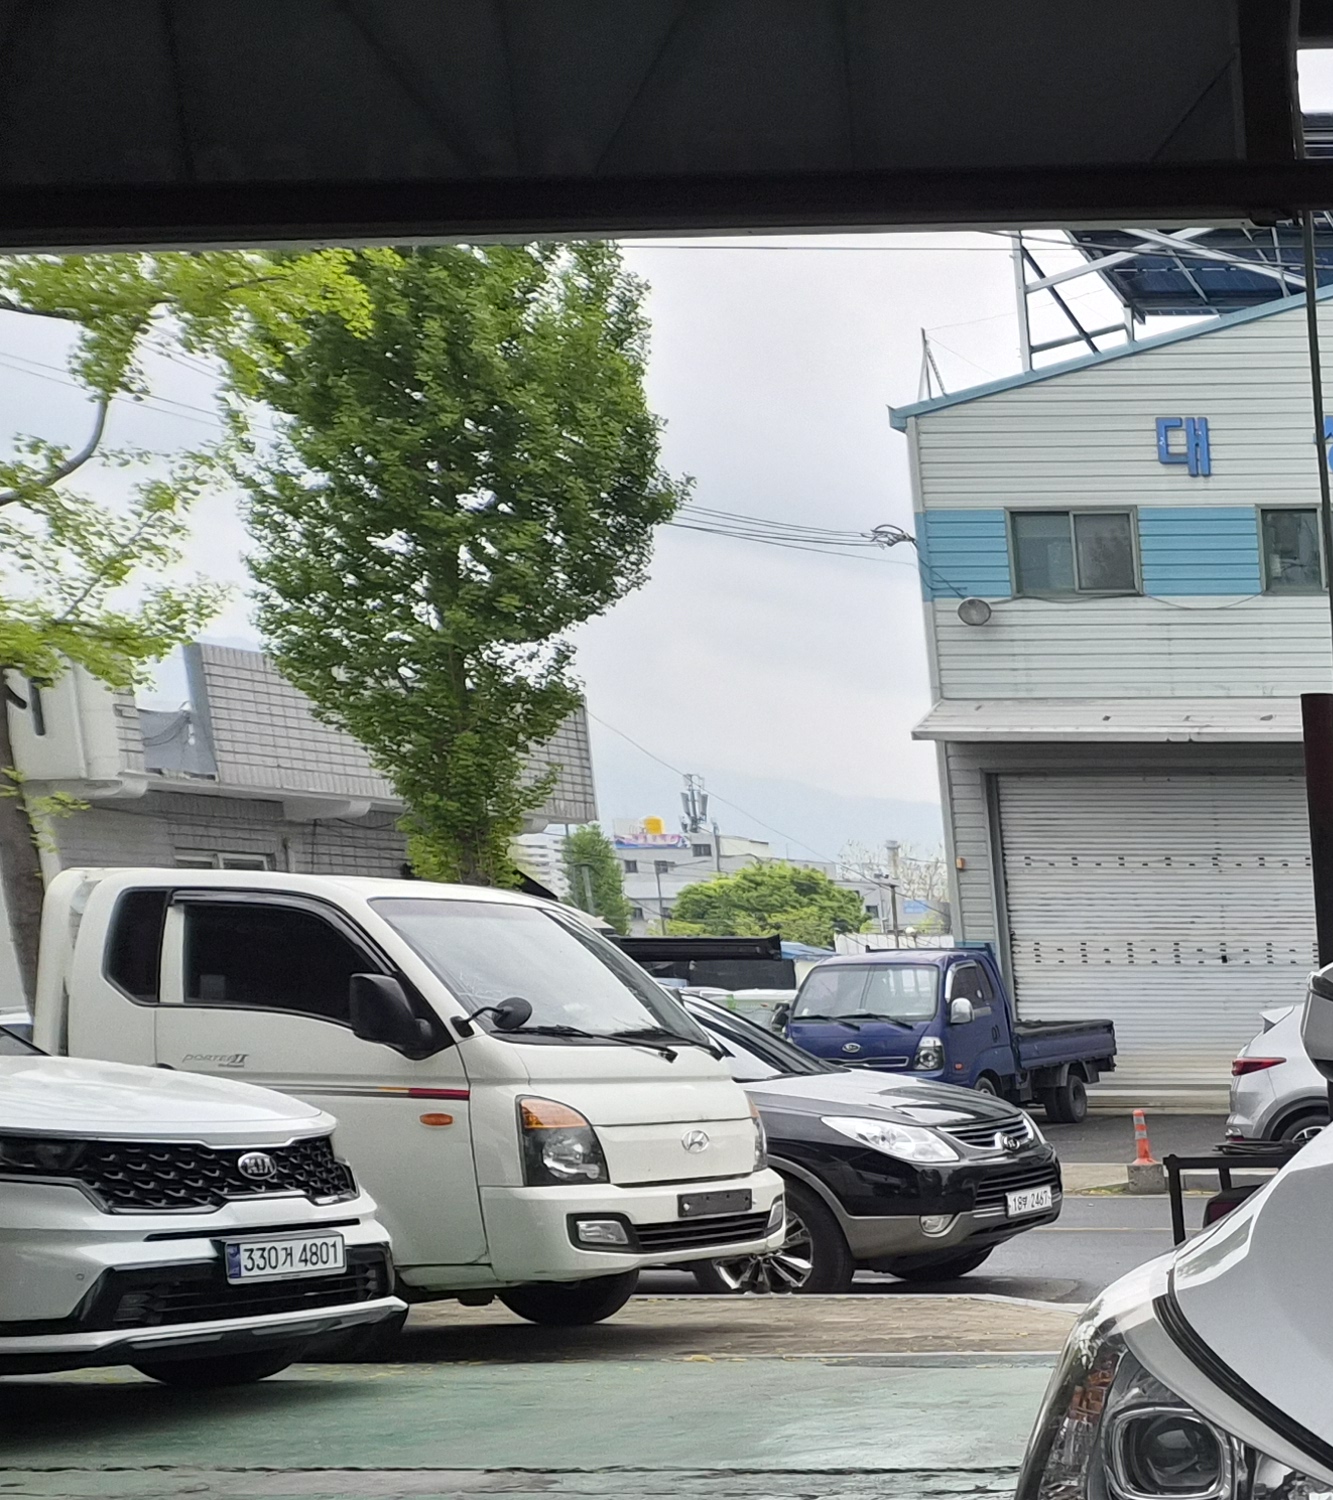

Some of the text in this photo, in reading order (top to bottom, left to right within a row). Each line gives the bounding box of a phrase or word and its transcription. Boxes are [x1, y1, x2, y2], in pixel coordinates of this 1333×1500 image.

[245, 1157, 274, 1174] KIA
[243, 1240, 338, 1272] 330거 4801
